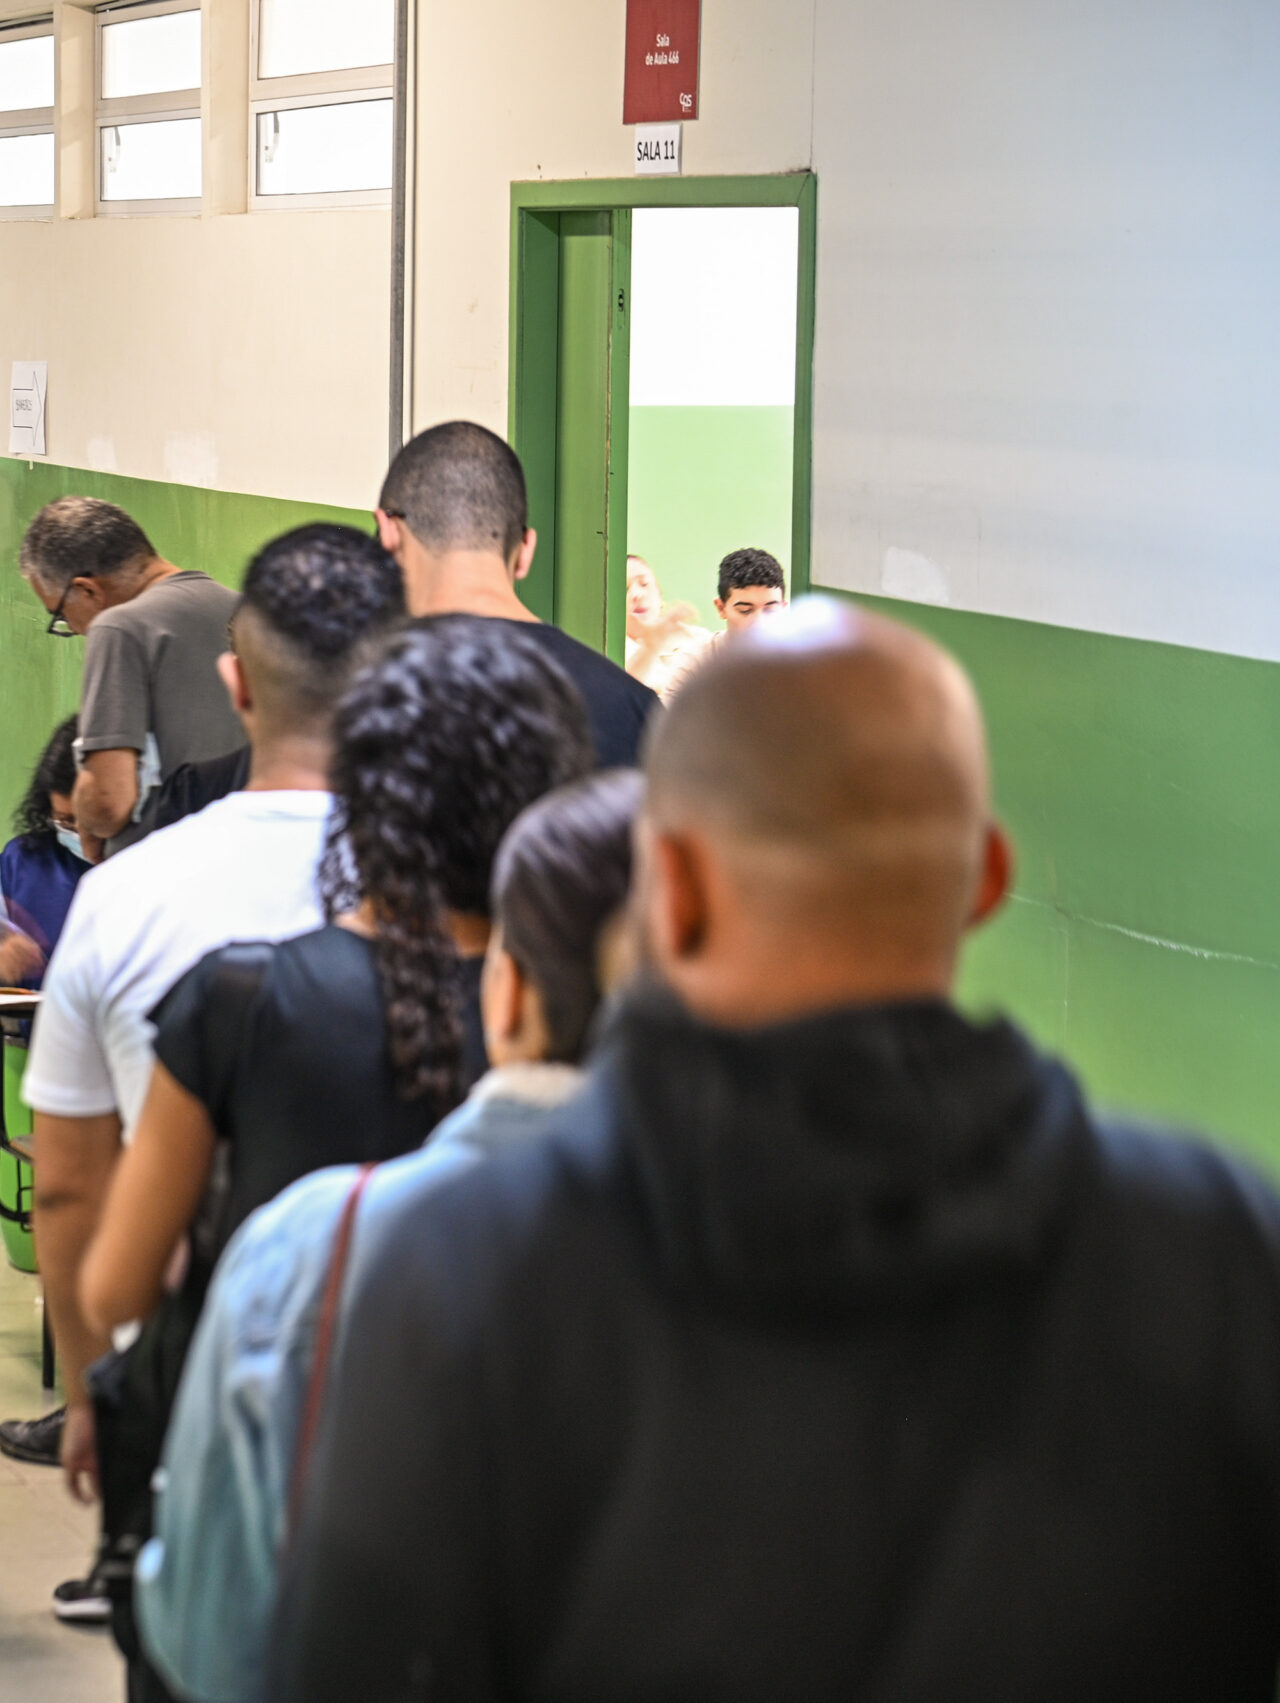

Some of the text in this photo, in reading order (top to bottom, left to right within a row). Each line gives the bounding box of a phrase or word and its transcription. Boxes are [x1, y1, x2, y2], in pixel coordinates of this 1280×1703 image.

[656, 33, 670, 47] Sala
[645, 50, 679, 66] de Aula 466
[636, 141, 676, 161] SALA 11
